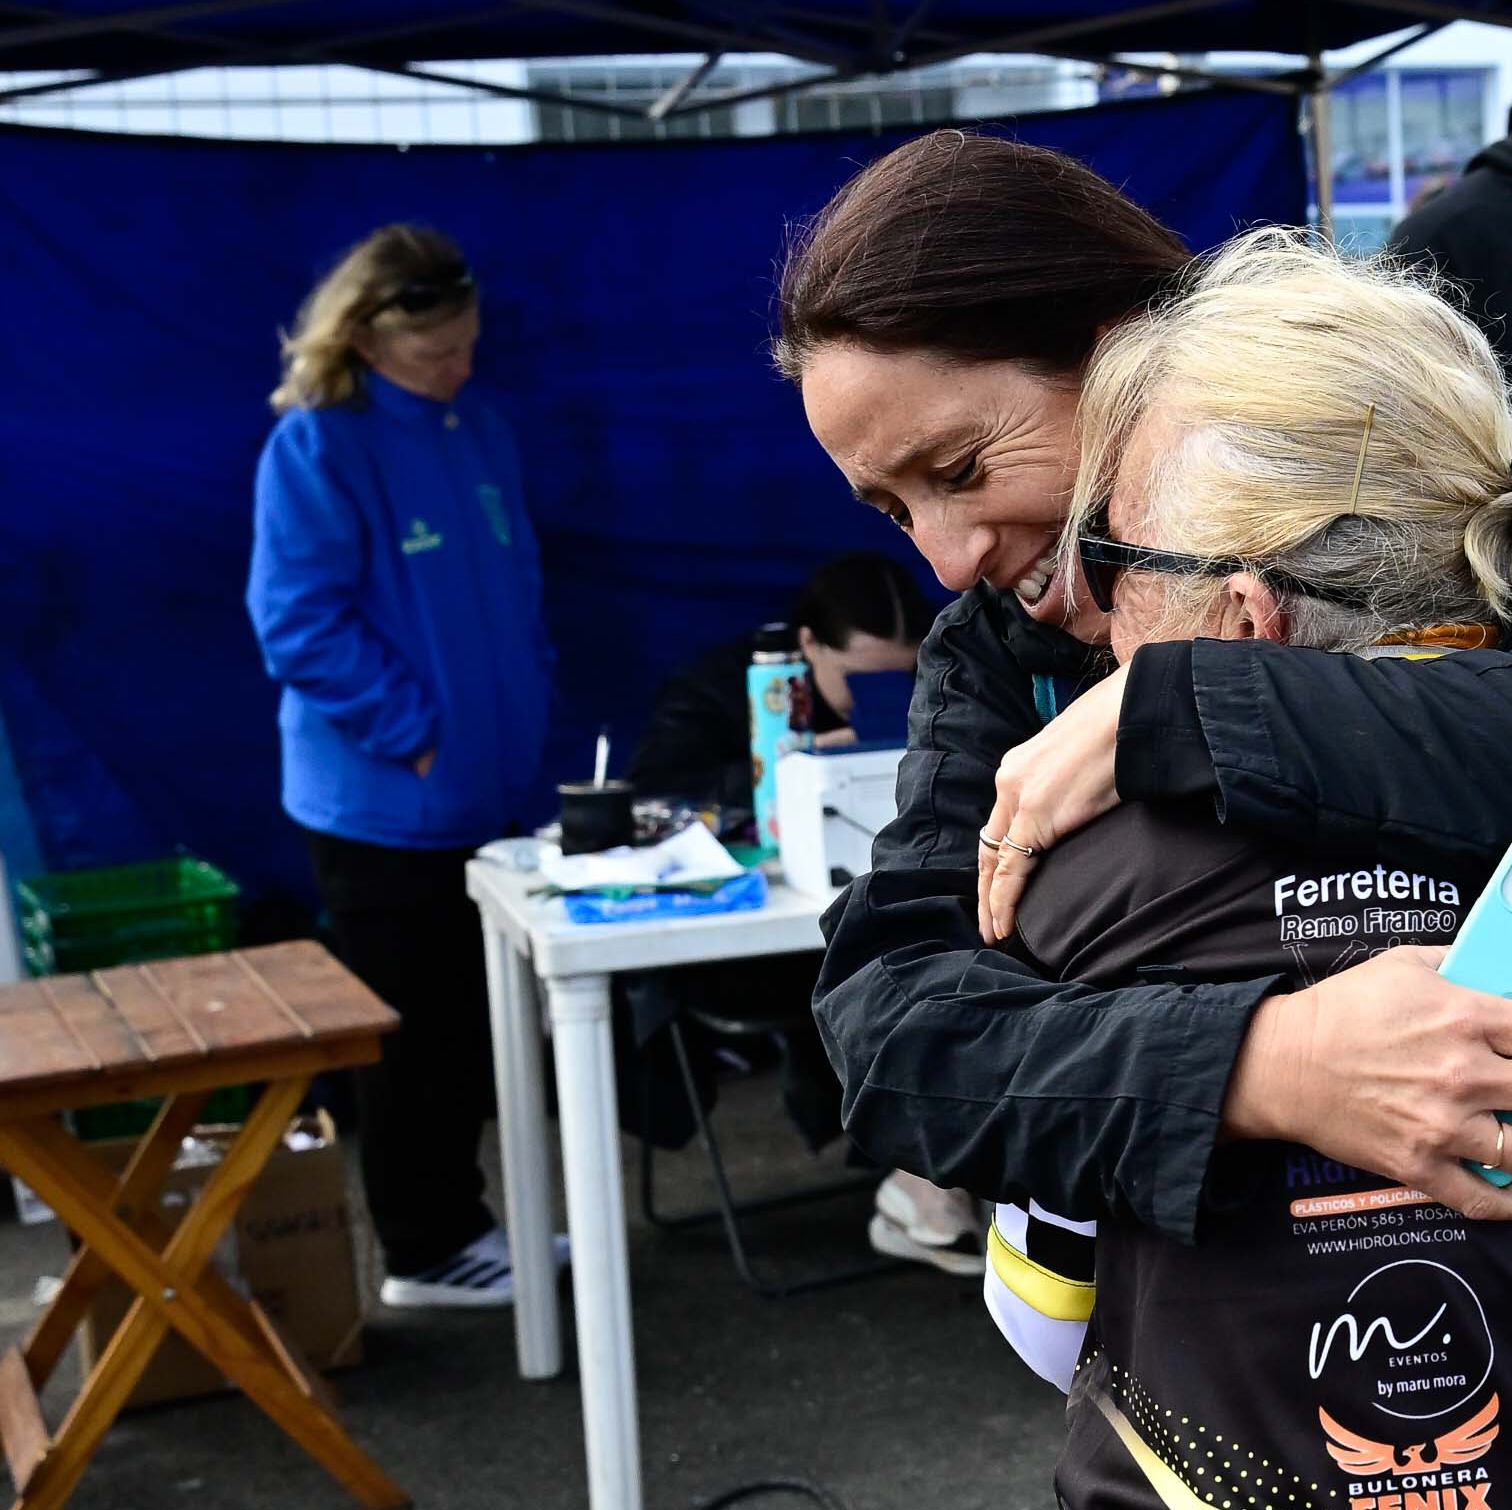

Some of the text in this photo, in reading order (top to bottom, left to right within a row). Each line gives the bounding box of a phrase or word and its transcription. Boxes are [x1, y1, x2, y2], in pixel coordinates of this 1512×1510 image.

[1280, 907, 1457, 942] Remo Franco
[1295, 1198, 1356, 1214] PLÁSTICOS
[1358, 1197, 1367, 1206] Y
[1293, 1222, 1318, 1235] EVA
[1321, 1215, 1368, 1232] PERÓN
[1371, 1212, 1404, 1229] 5863
[1415, 1207, 1463, 1221] ROSAR
[1307, 1229, 1467, 1255] WWW.HIDROLONG.COM
[1388, 1352, 1448, 1367] EVENTOS
[1377, 1374, 1467, 1398] by maru mora
[1349, 1467, 1489, 1495] BULONERA
